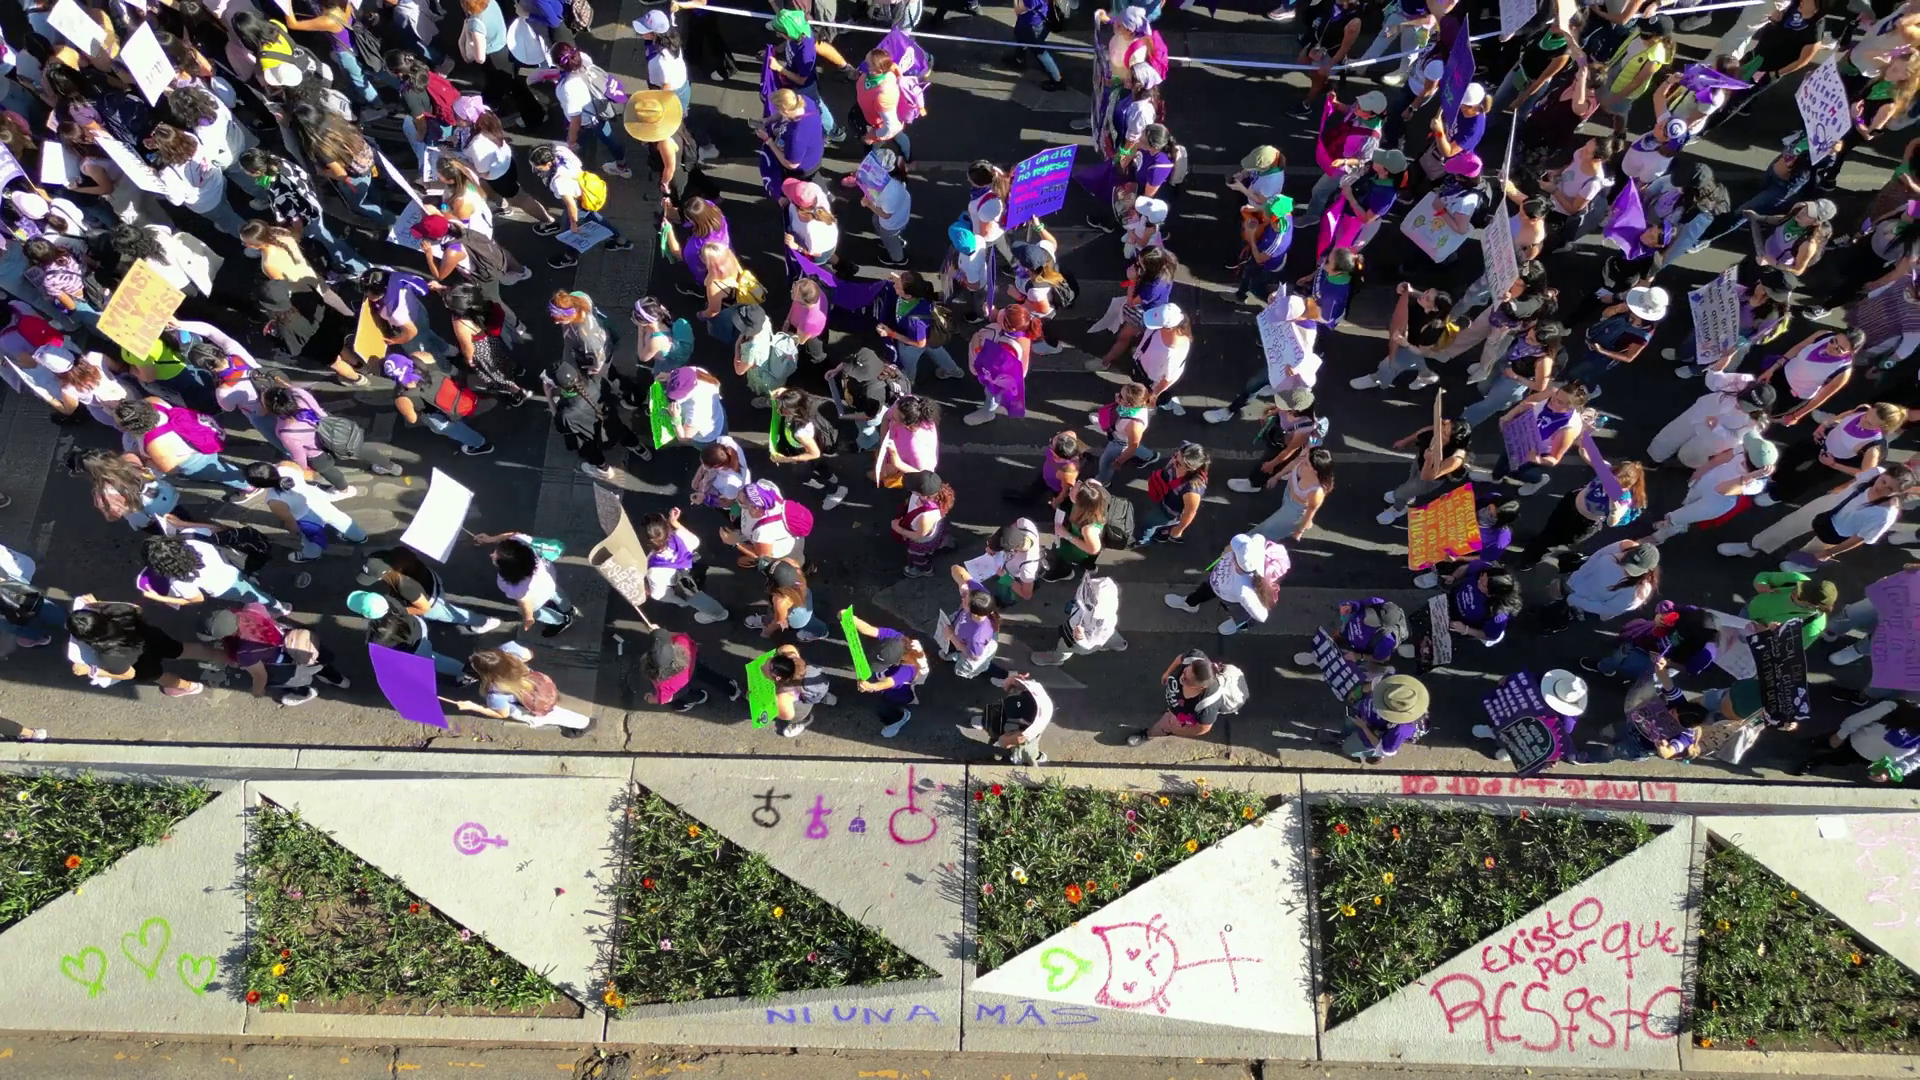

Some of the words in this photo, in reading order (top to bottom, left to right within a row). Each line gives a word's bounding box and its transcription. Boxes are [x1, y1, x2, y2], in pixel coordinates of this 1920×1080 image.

[105, 270, 148, 328] VIVAS
[131, 303, 145, 318] Y
[1517, 672, 1528, 686] NO
[1503, 687, 1518, 714] PARA
[1508, 680, 1528, 709] MUJER
[766, 1006, 812, 1025] NI
[833, 1004, 940, 1025] UNA
